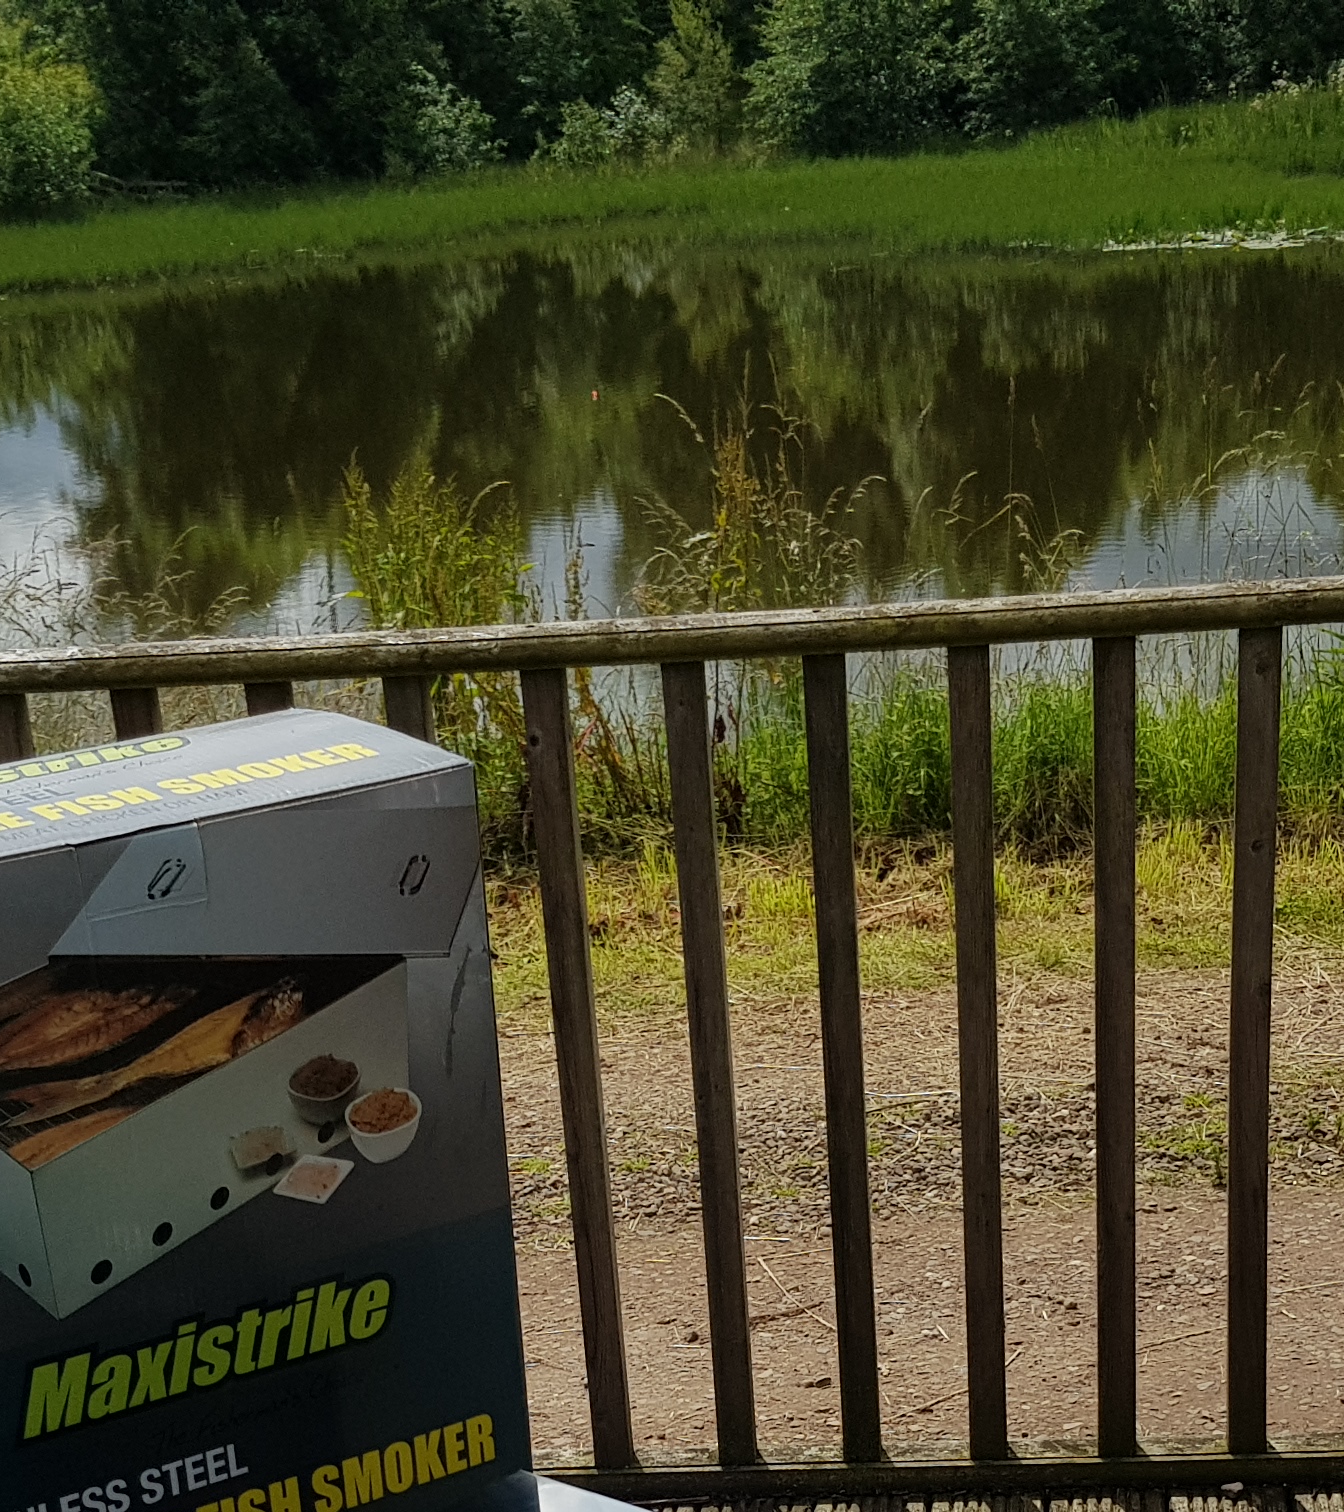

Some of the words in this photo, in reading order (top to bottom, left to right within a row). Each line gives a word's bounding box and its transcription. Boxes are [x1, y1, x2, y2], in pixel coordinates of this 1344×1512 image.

[27, 786, 162, 821] FISH
[157, 742, 381, 795] SMOKER
[65, 804, 153, 831] CHICKEN
[22, 1278, 391, 1440] Maxistrike
[139, 1443, 250, 1504] STEEL
